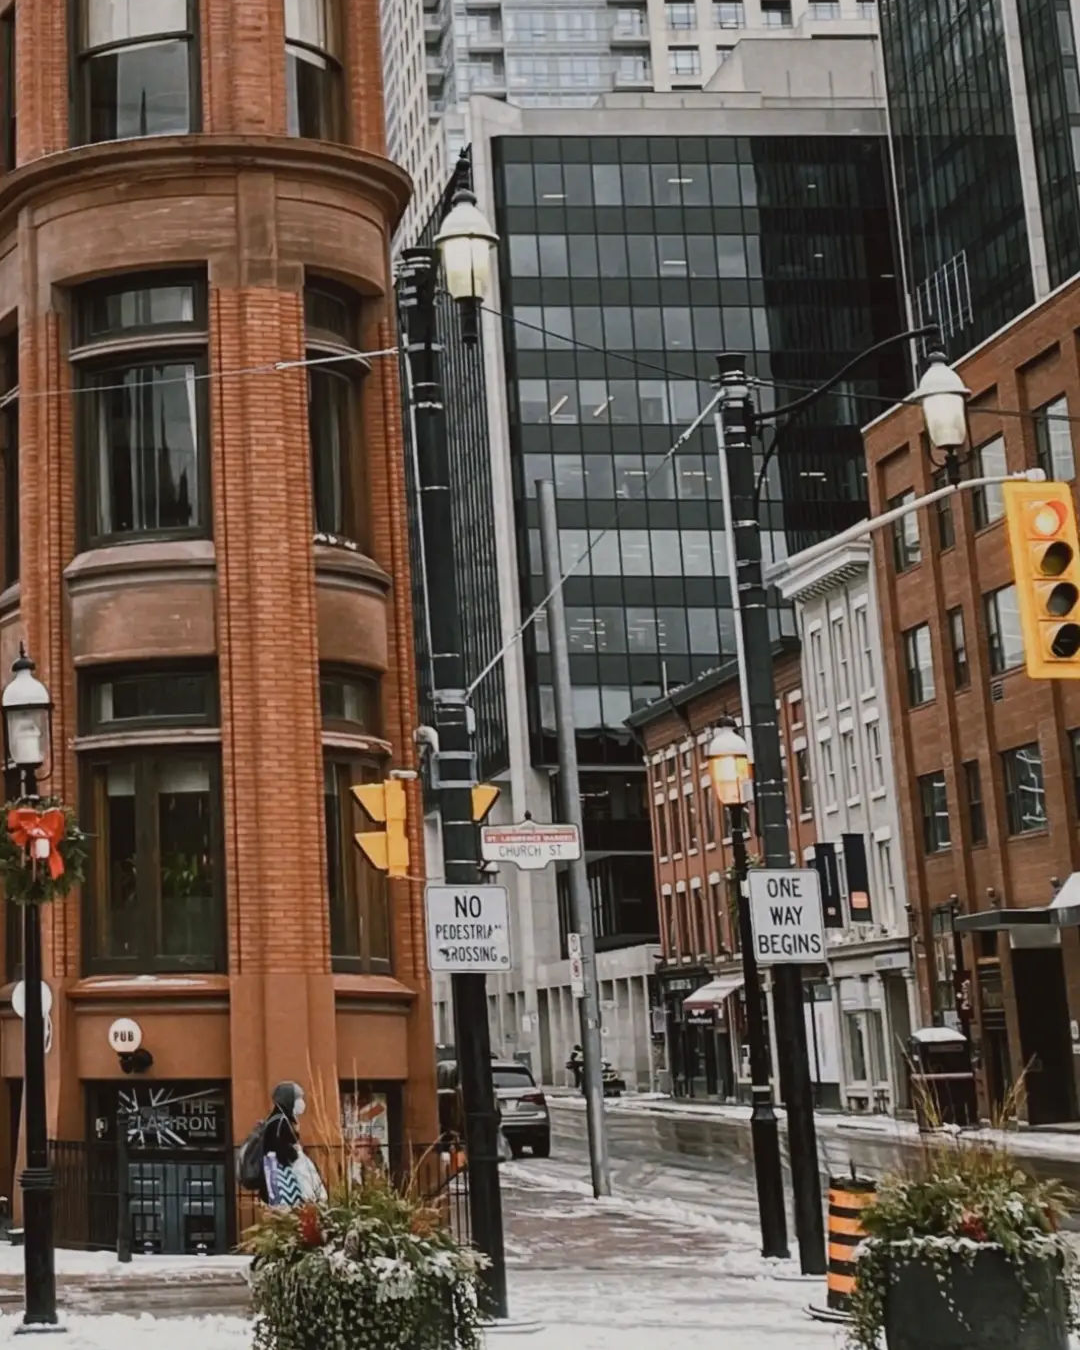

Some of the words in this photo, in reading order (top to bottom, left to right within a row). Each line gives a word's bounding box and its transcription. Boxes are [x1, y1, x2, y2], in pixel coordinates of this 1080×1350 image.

[498, 845, 541, 857] CHURCH
[549, 844, 562, 856] ST
[767, 877, 802, 898] ONE
[454, 895, 482, 918] NO
[769, 906, 803, 926] WAY
[758, 934, 821, 955] BEGINS
[113, 1031, 134, 1042] PUB
[180, 1100, 216, 1114] THE
